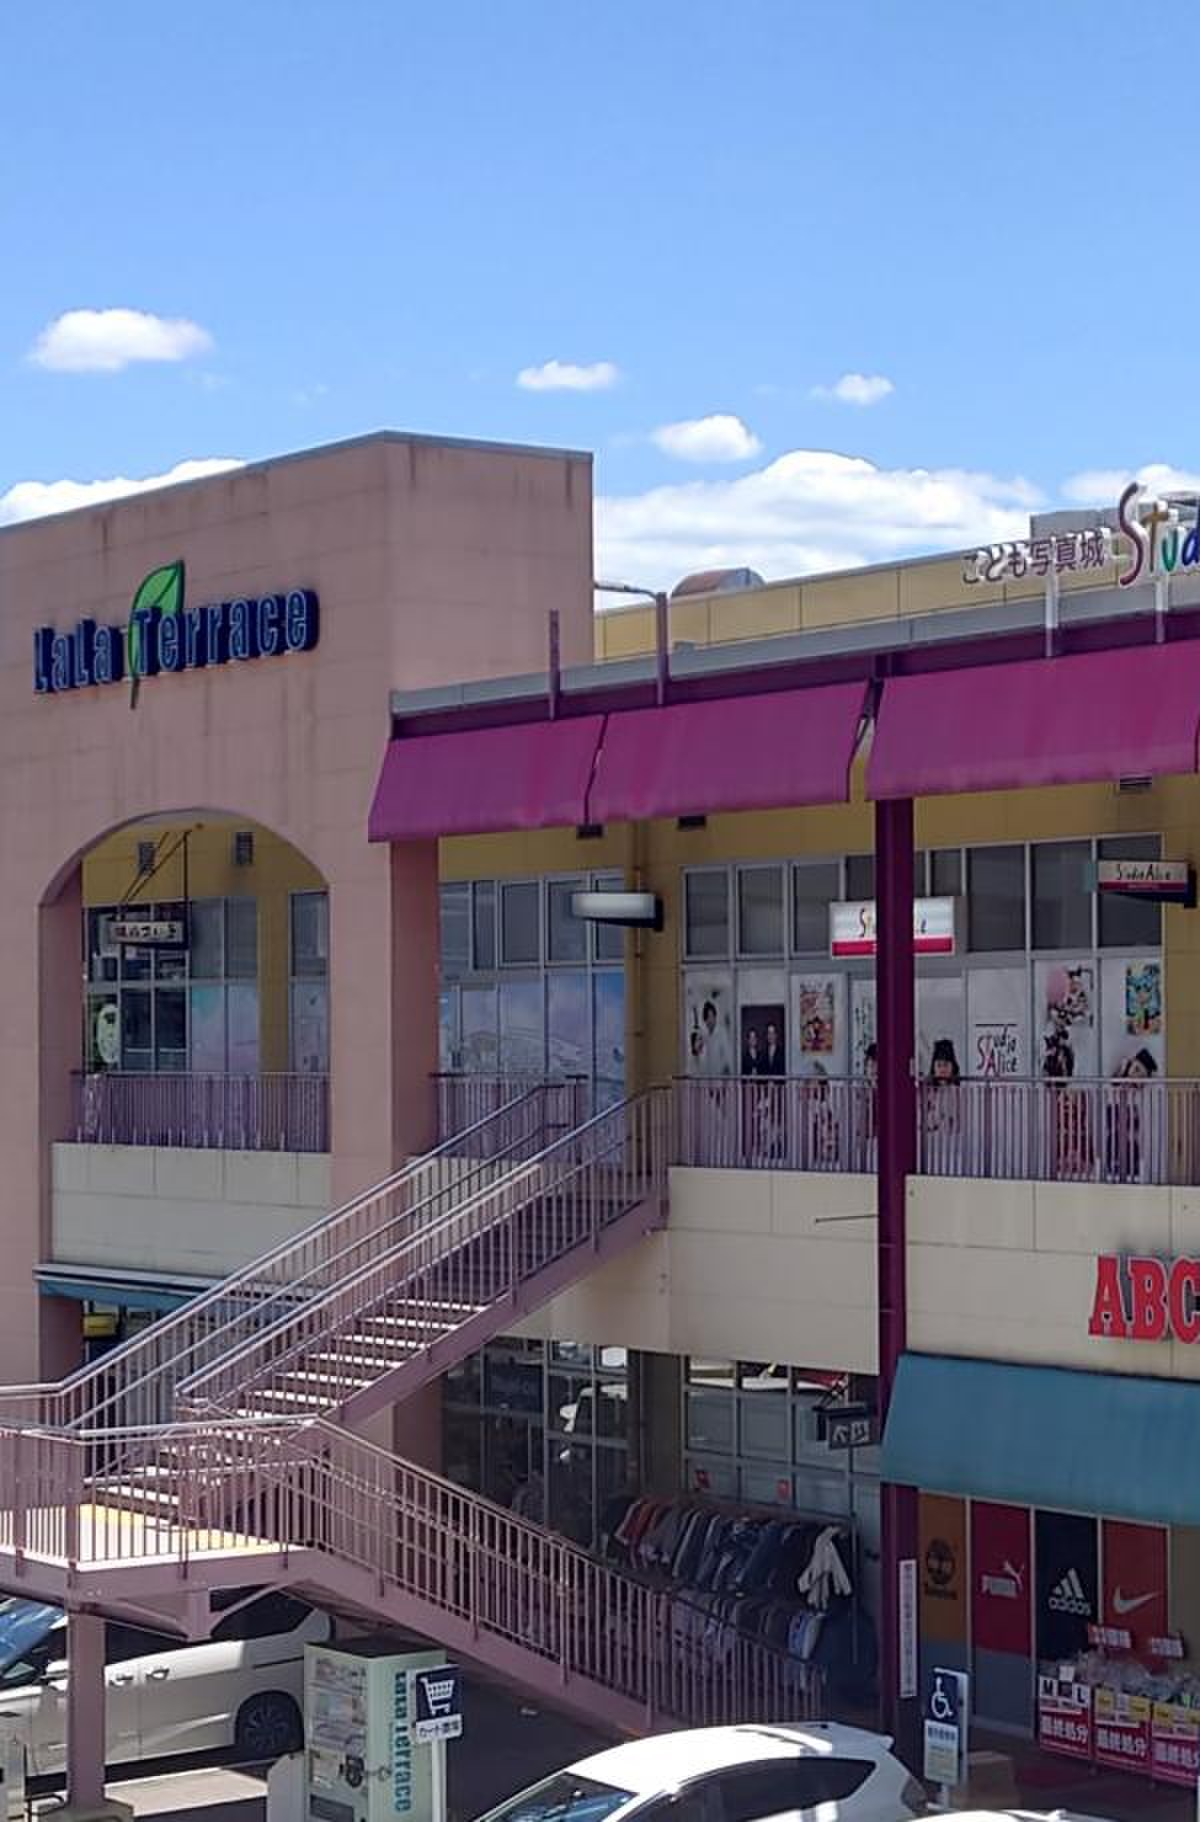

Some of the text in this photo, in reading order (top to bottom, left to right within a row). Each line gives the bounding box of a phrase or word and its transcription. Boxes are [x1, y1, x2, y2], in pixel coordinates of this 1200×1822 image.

[962, 528, 1105, 584] こども写真城
[133, 588, 318, 676] Terrace
